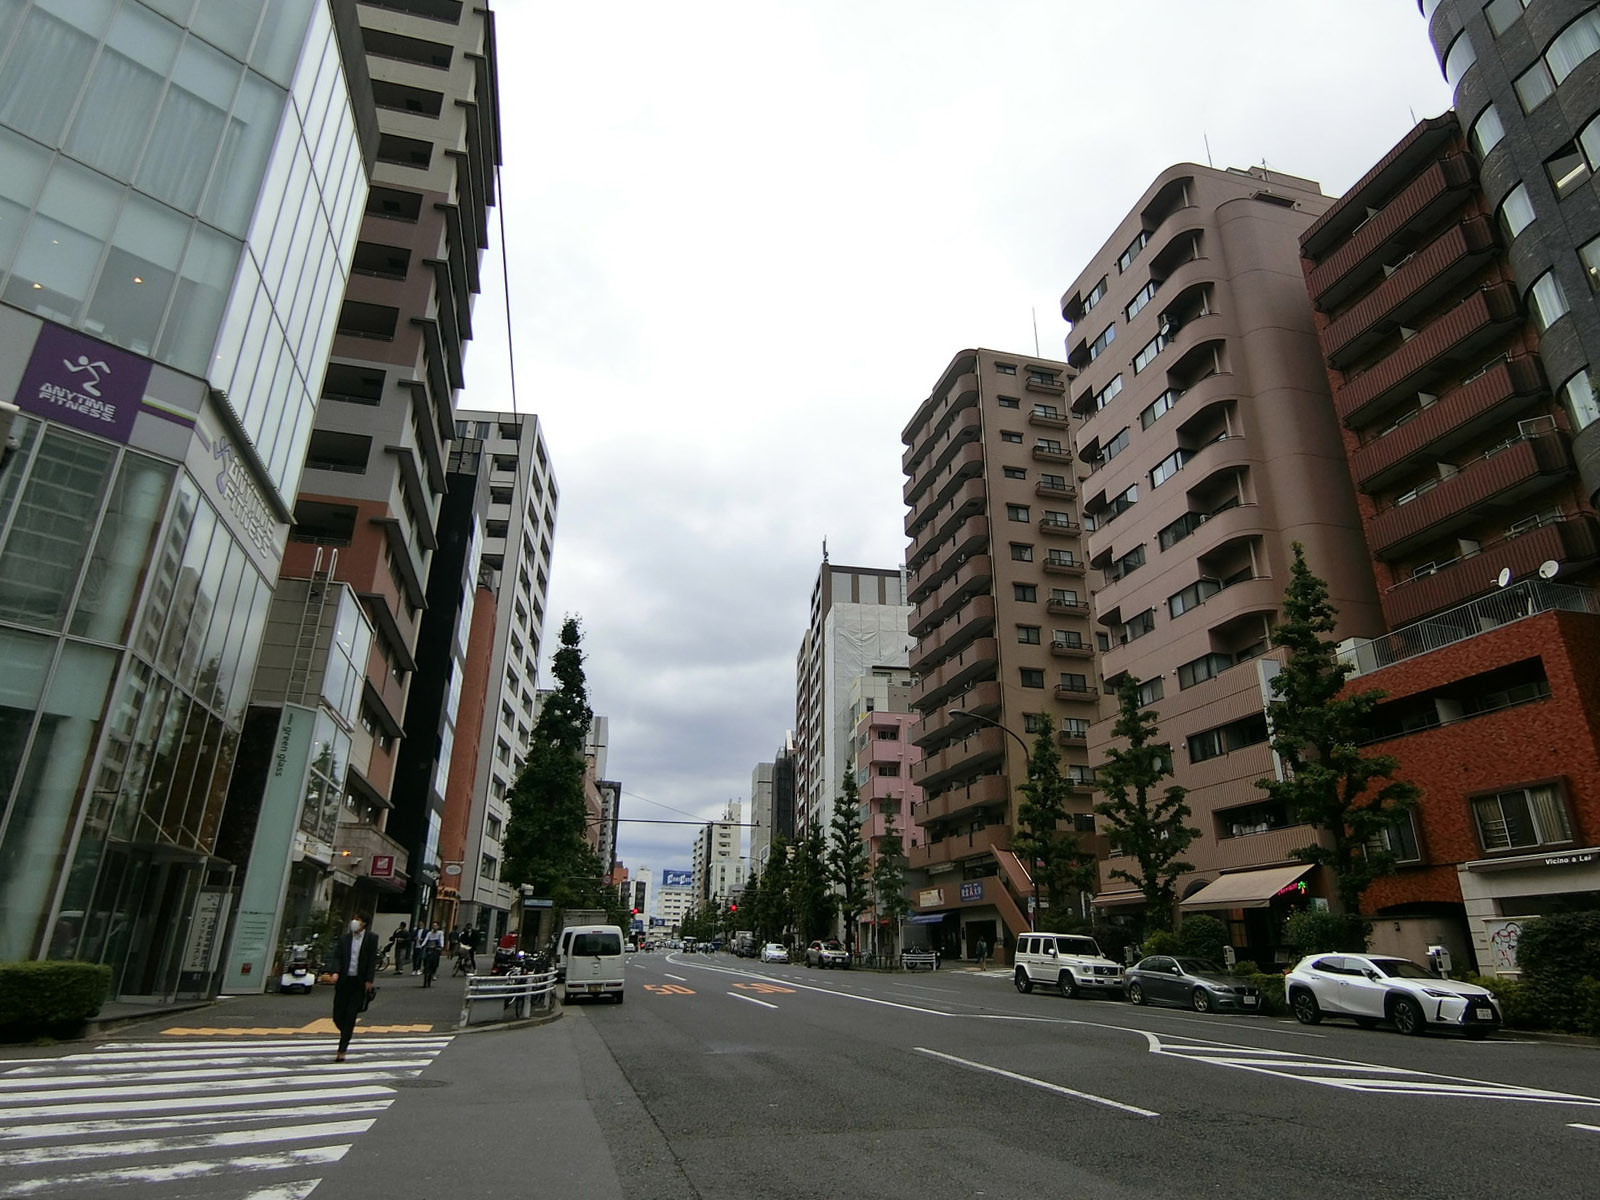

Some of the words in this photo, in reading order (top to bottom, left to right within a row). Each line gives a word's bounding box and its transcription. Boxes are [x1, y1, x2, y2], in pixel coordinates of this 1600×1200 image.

[39, 391, 114, 423] FITNESS
[40, 382, 116, 415] ANYTIME
[227, 456, 276, 538] ANYTIME
[223, 481, 271, 559] FITNESS
[281, 726, 292, 752] green
[275, 753, 287, 777] glass
[1545, 857, 1569, 865] Vicino
[643, 984, 697, 995] 50
